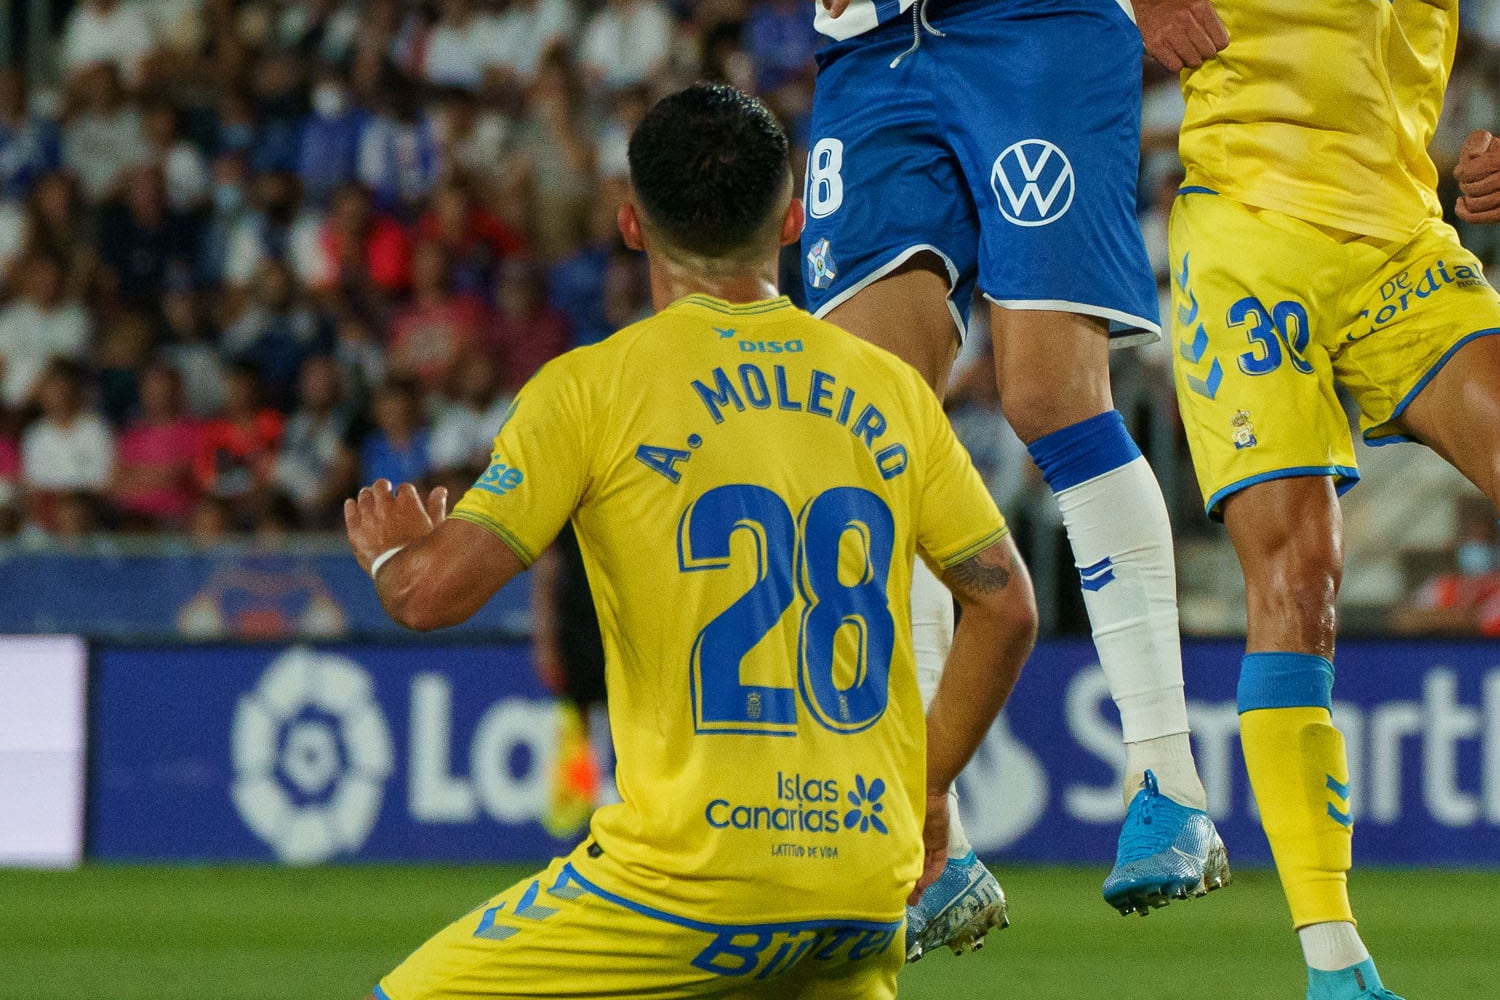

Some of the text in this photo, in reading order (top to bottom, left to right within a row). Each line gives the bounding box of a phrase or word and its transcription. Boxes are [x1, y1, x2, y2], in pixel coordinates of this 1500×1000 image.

[1226, 296, 1315, 377] 30
[634, 362, 909, 484] A. MOLEIRO
[677, 483, 896, 738] 28
[704, 798, 840, 834] Canarias
[777, 771, 840, 803] Islas
